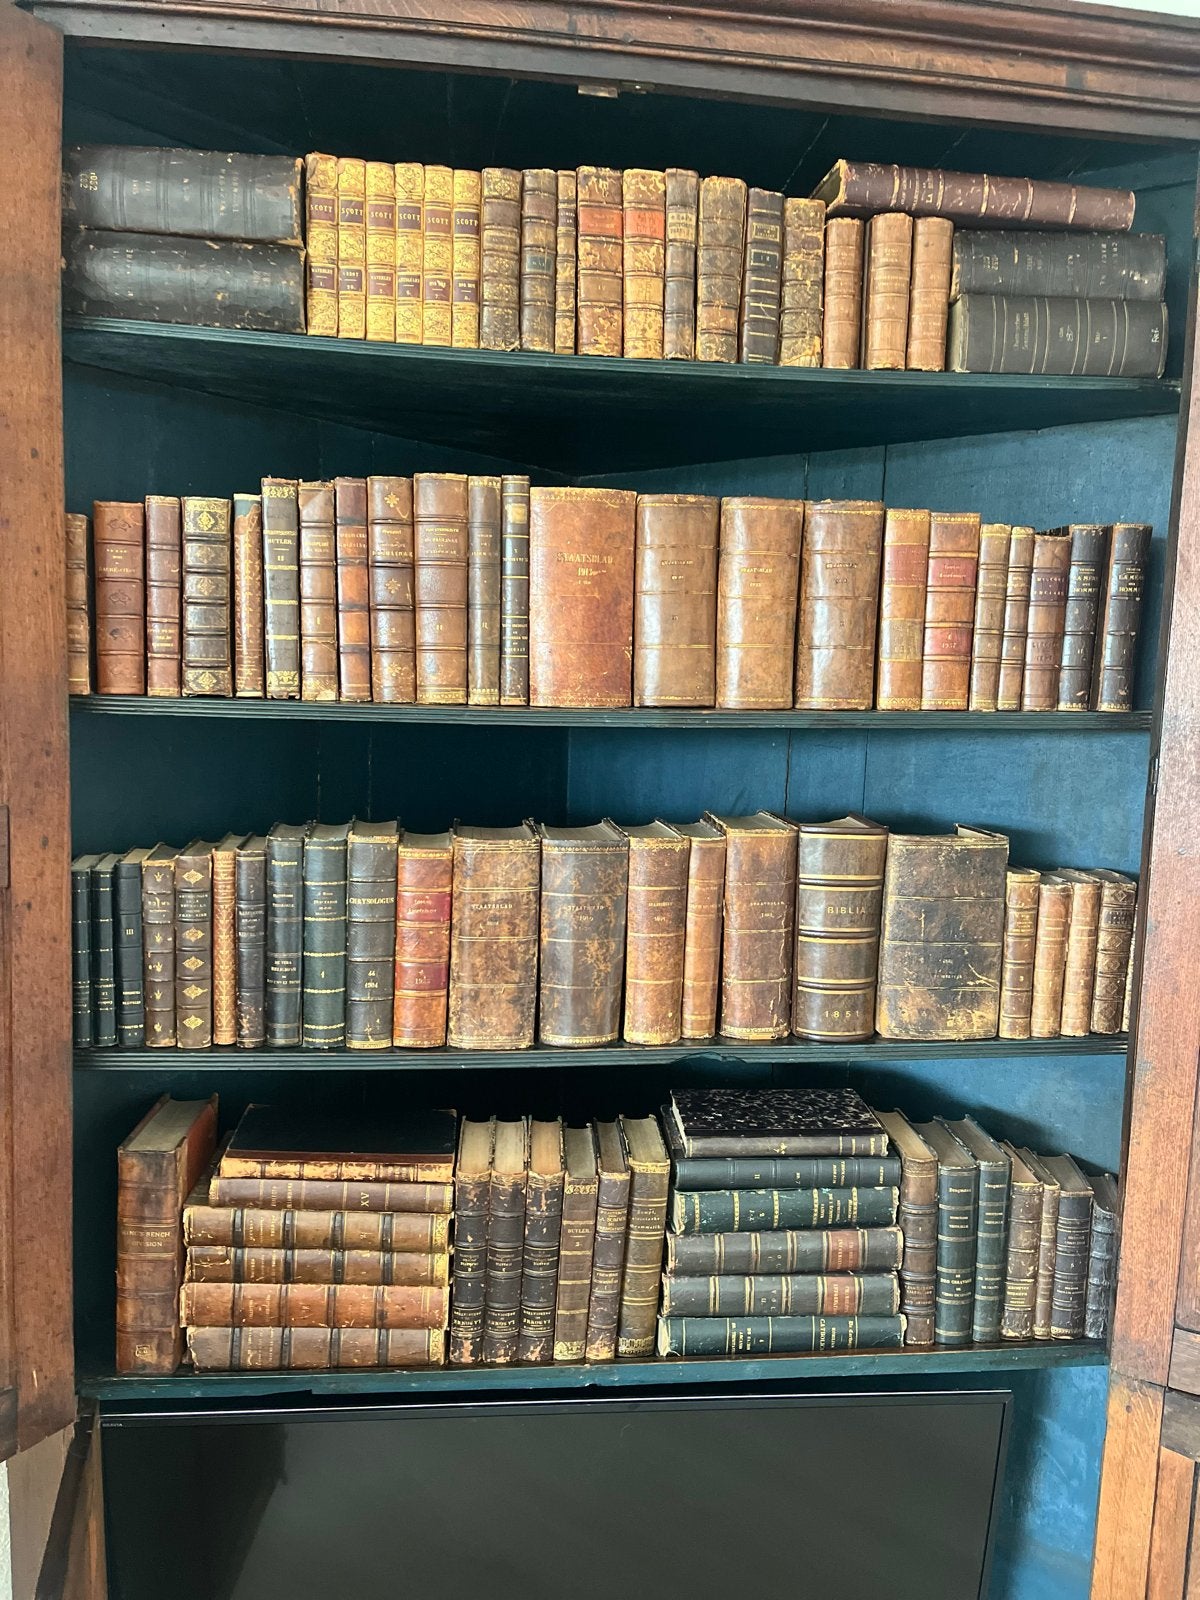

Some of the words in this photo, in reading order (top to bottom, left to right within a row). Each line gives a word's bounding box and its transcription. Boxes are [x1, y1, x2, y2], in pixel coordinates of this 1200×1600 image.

[310, 204, 333, 213] SCOTT
[341, 207, 363, 216] SCOTT
[370, 211, 392, 220] SCOTT
[399, 213, 421, 221] SCOTT
[427, 217, 449, 225] SCOTT
[456, 218, 479, 227] SCOTT
[349, 897, 396, 905] CHRYSOLOGUS
[827, 906, 866, 914] BIBLIA
[360, 1191, 369, 1207] XV
